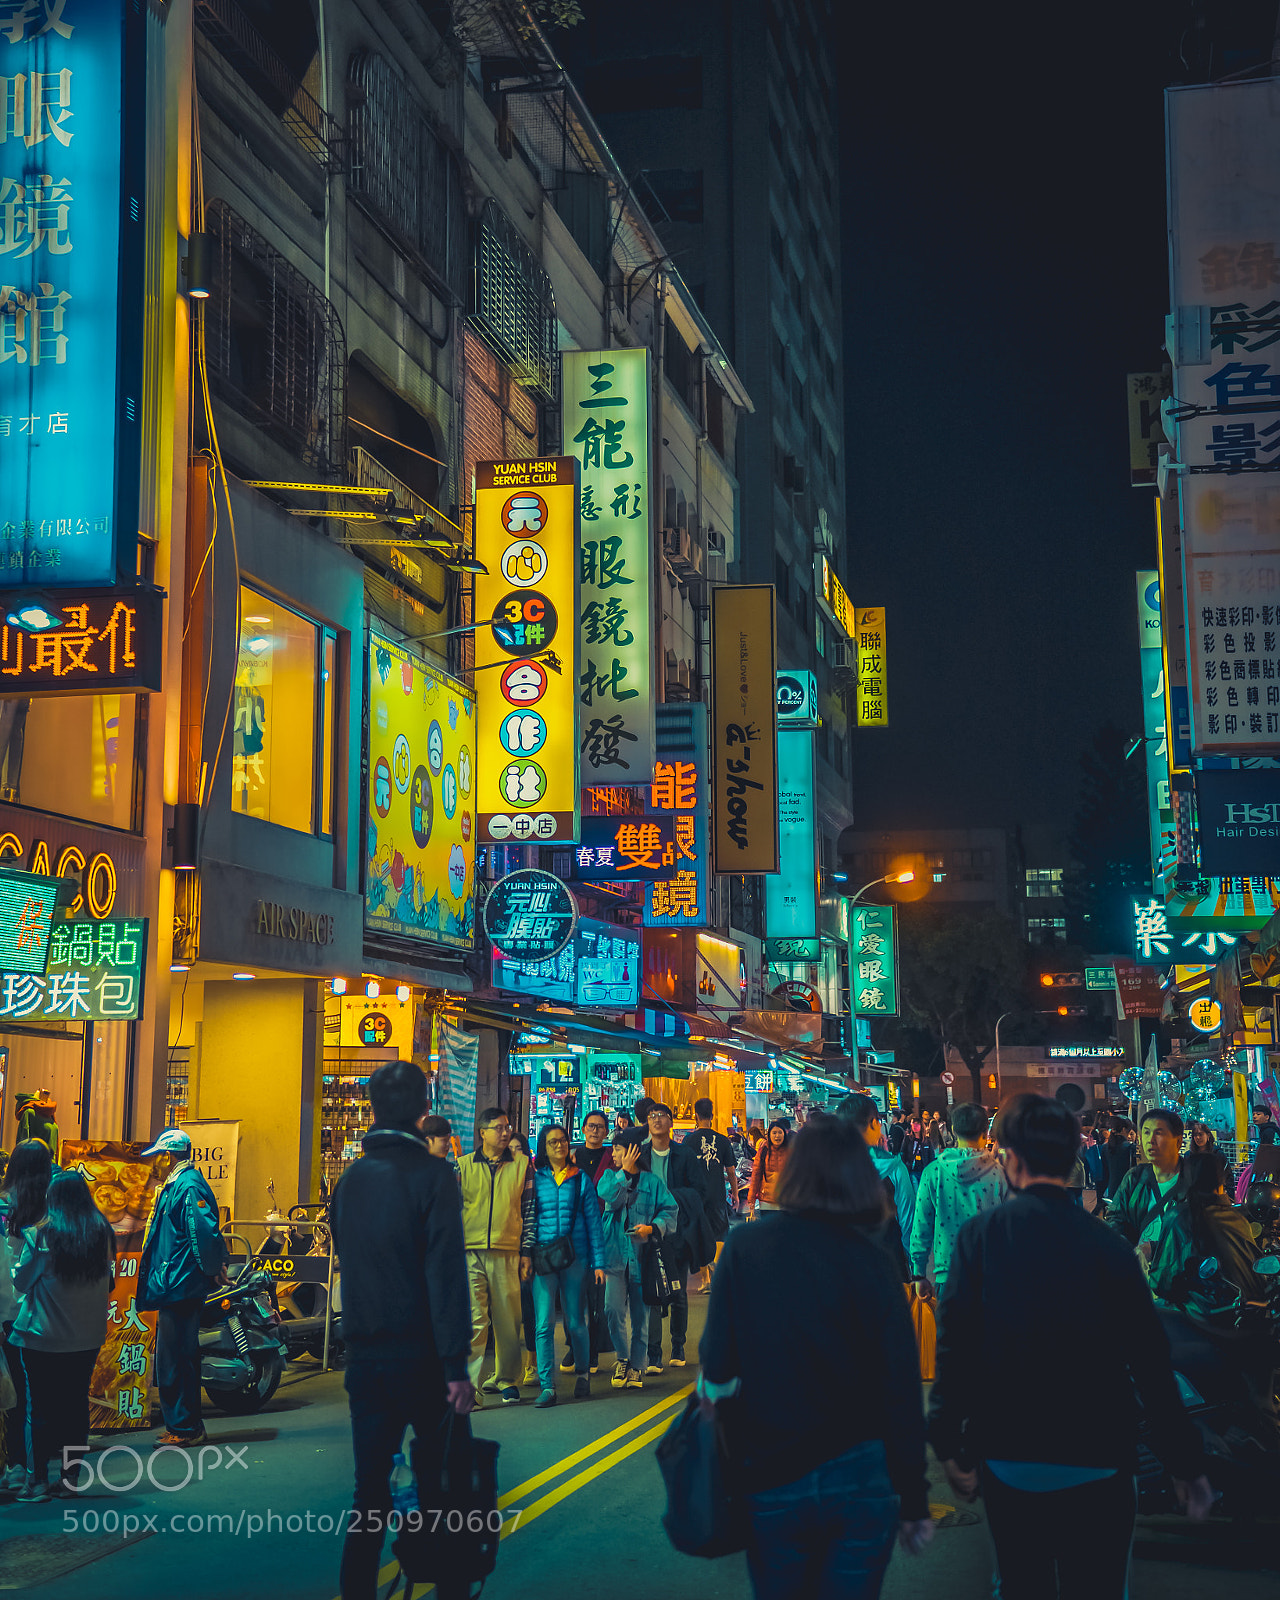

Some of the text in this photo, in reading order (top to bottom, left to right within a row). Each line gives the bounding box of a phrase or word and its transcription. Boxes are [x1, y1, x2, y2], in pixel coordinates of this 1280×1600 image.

[493, 462, 556, 475] YUAN HSIN
[493, 473, 557, 485] SERVICE CLUB
[505, 599, 545, 622] 3C
[860, 632, 883, 720] 聯成電腦
[493, 817, 552, 835] 一中店
[1216, 826, 1245, 838] Hair
[503, 882, 558, 890] YUAN HSIN
[504, 892, 551, 914] 元心
[257, 901, 334, 945] AIR SPACE
[50, 923, 140, 966] 鍋貼
[857, 909, 889, 1010] 仁愛眼鏡
[0, 971, 135, 1017] 珍珠包
[364, 1017, 386, 1030] 3C
[192, 1147, 223, 1161] BIG
[116, 1297, 150, 1420] 大鍋貼
